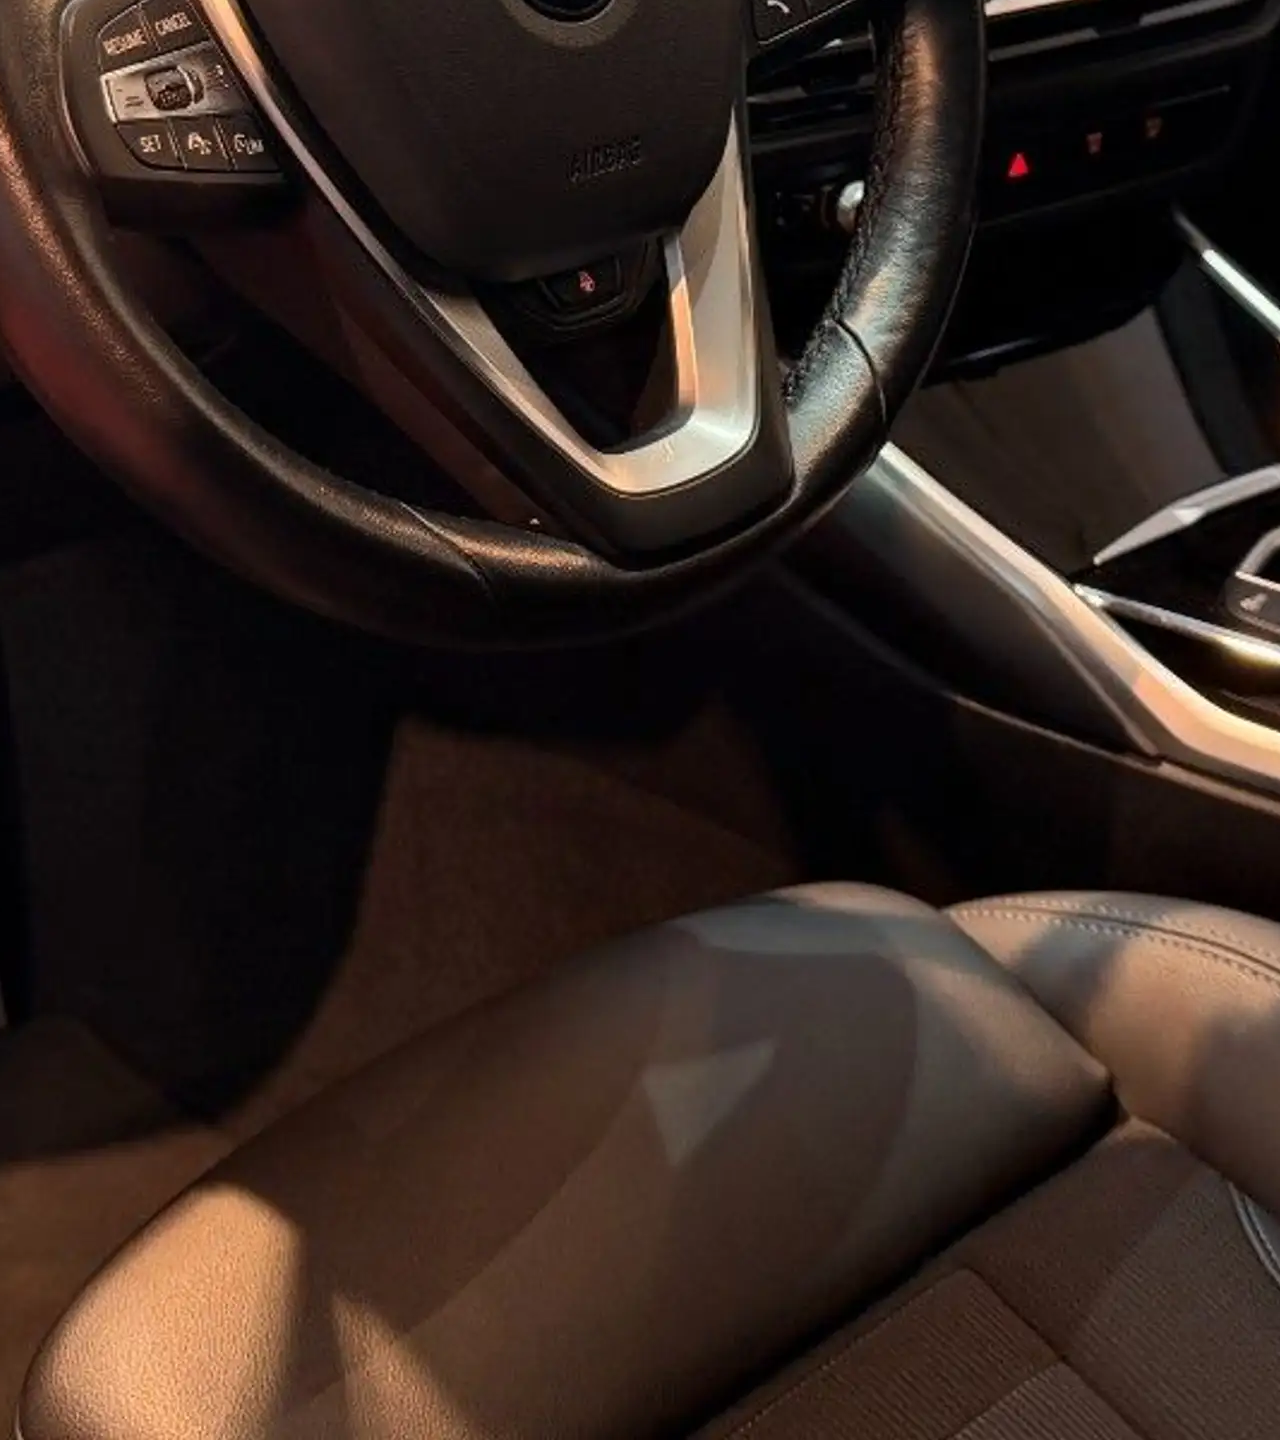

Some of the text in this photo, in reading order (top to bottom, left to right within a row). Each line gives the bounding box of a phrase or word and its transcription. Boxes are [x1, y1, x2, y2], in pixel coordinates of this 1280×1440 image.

[154, 11, 193, 37] CANCEL
[102, 28, 147, 57] RESUME
[139, 133, 162, 153] SET
